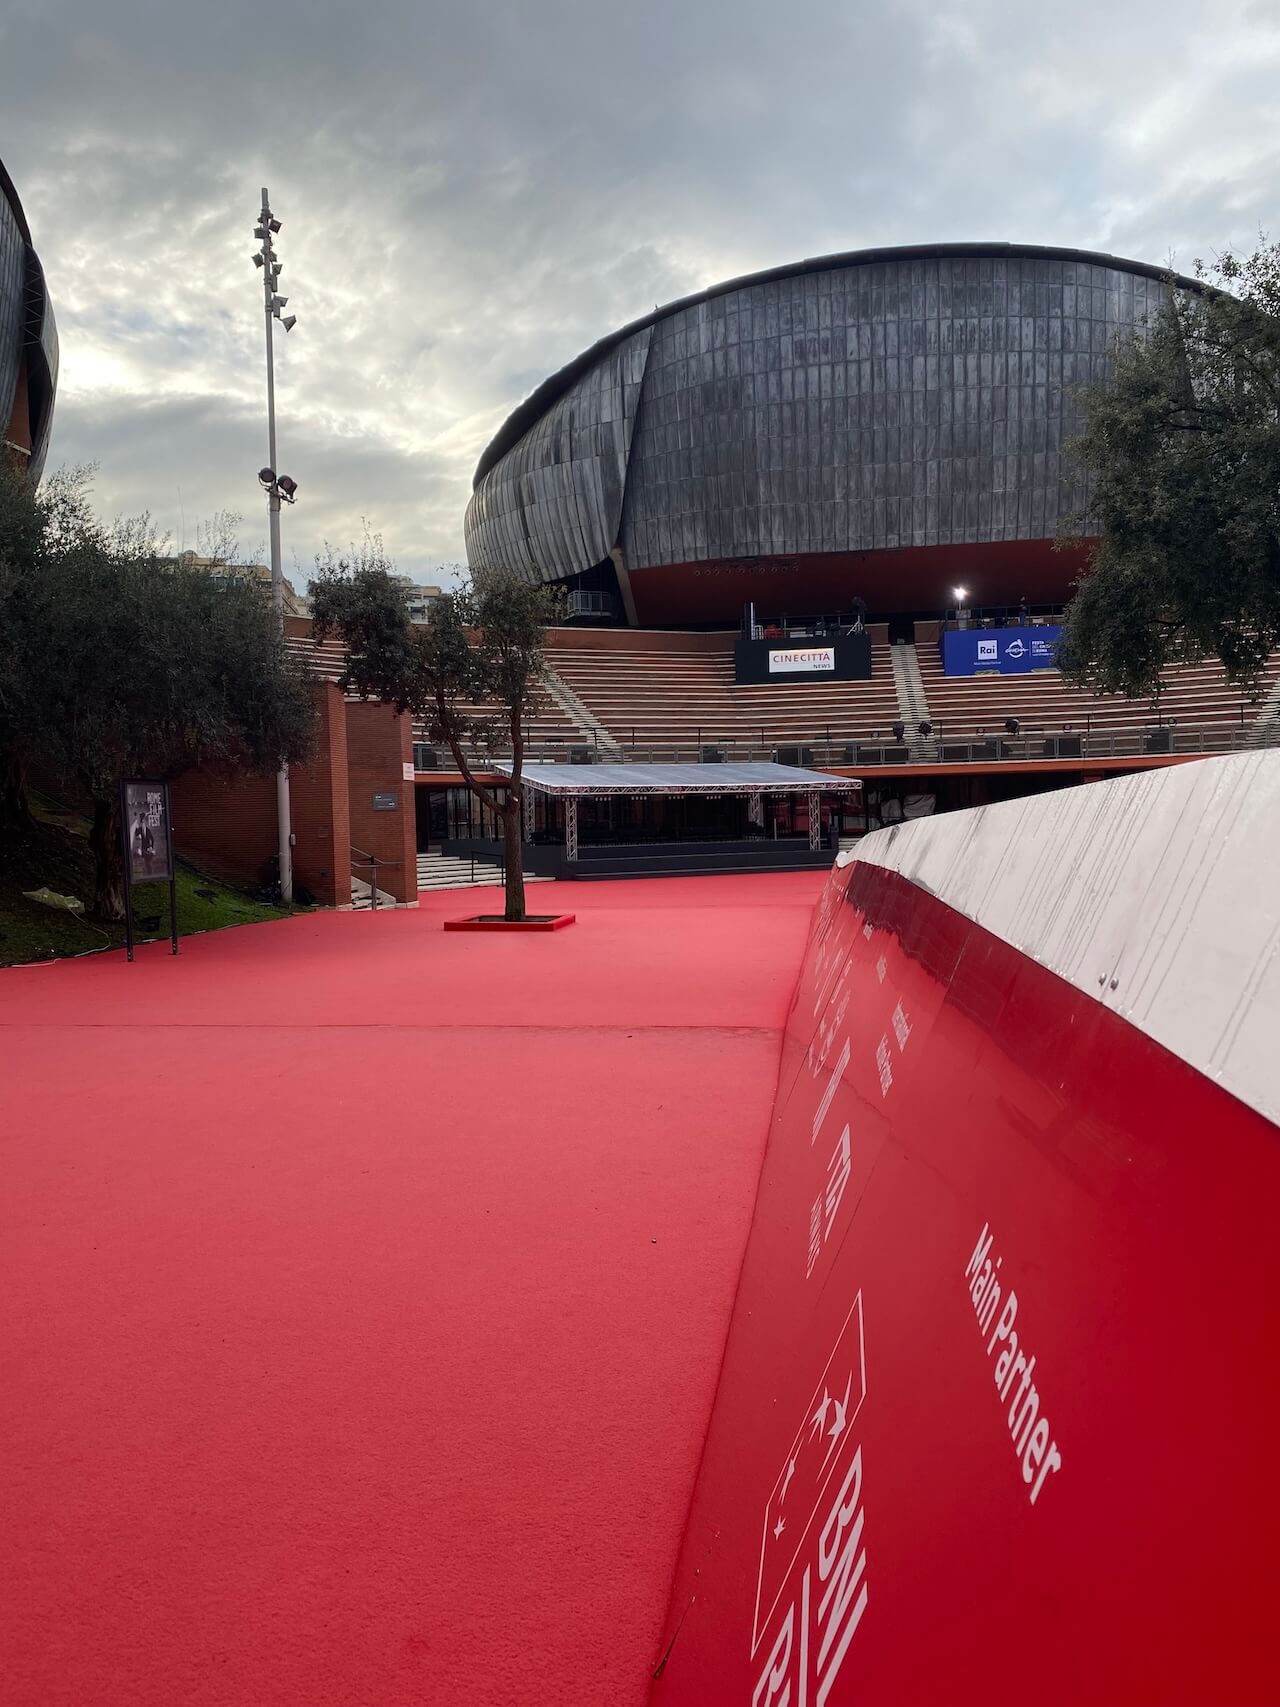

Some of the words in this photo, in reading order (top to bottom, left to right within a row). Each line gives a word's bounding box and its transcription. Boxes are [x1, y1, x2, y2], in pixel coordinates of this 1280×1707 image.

[980, 645, 995, 655] Rai
[773, 652, 830, 663] CINECITTÀ
[147, 792, 161, 804] ROME
[149, 804, 162, 815] FILM
[148, 815, 161, 827] FEST
[965, 1222, 1001, 1336] Main
[987, 1290, 1062, 1506] Partner
